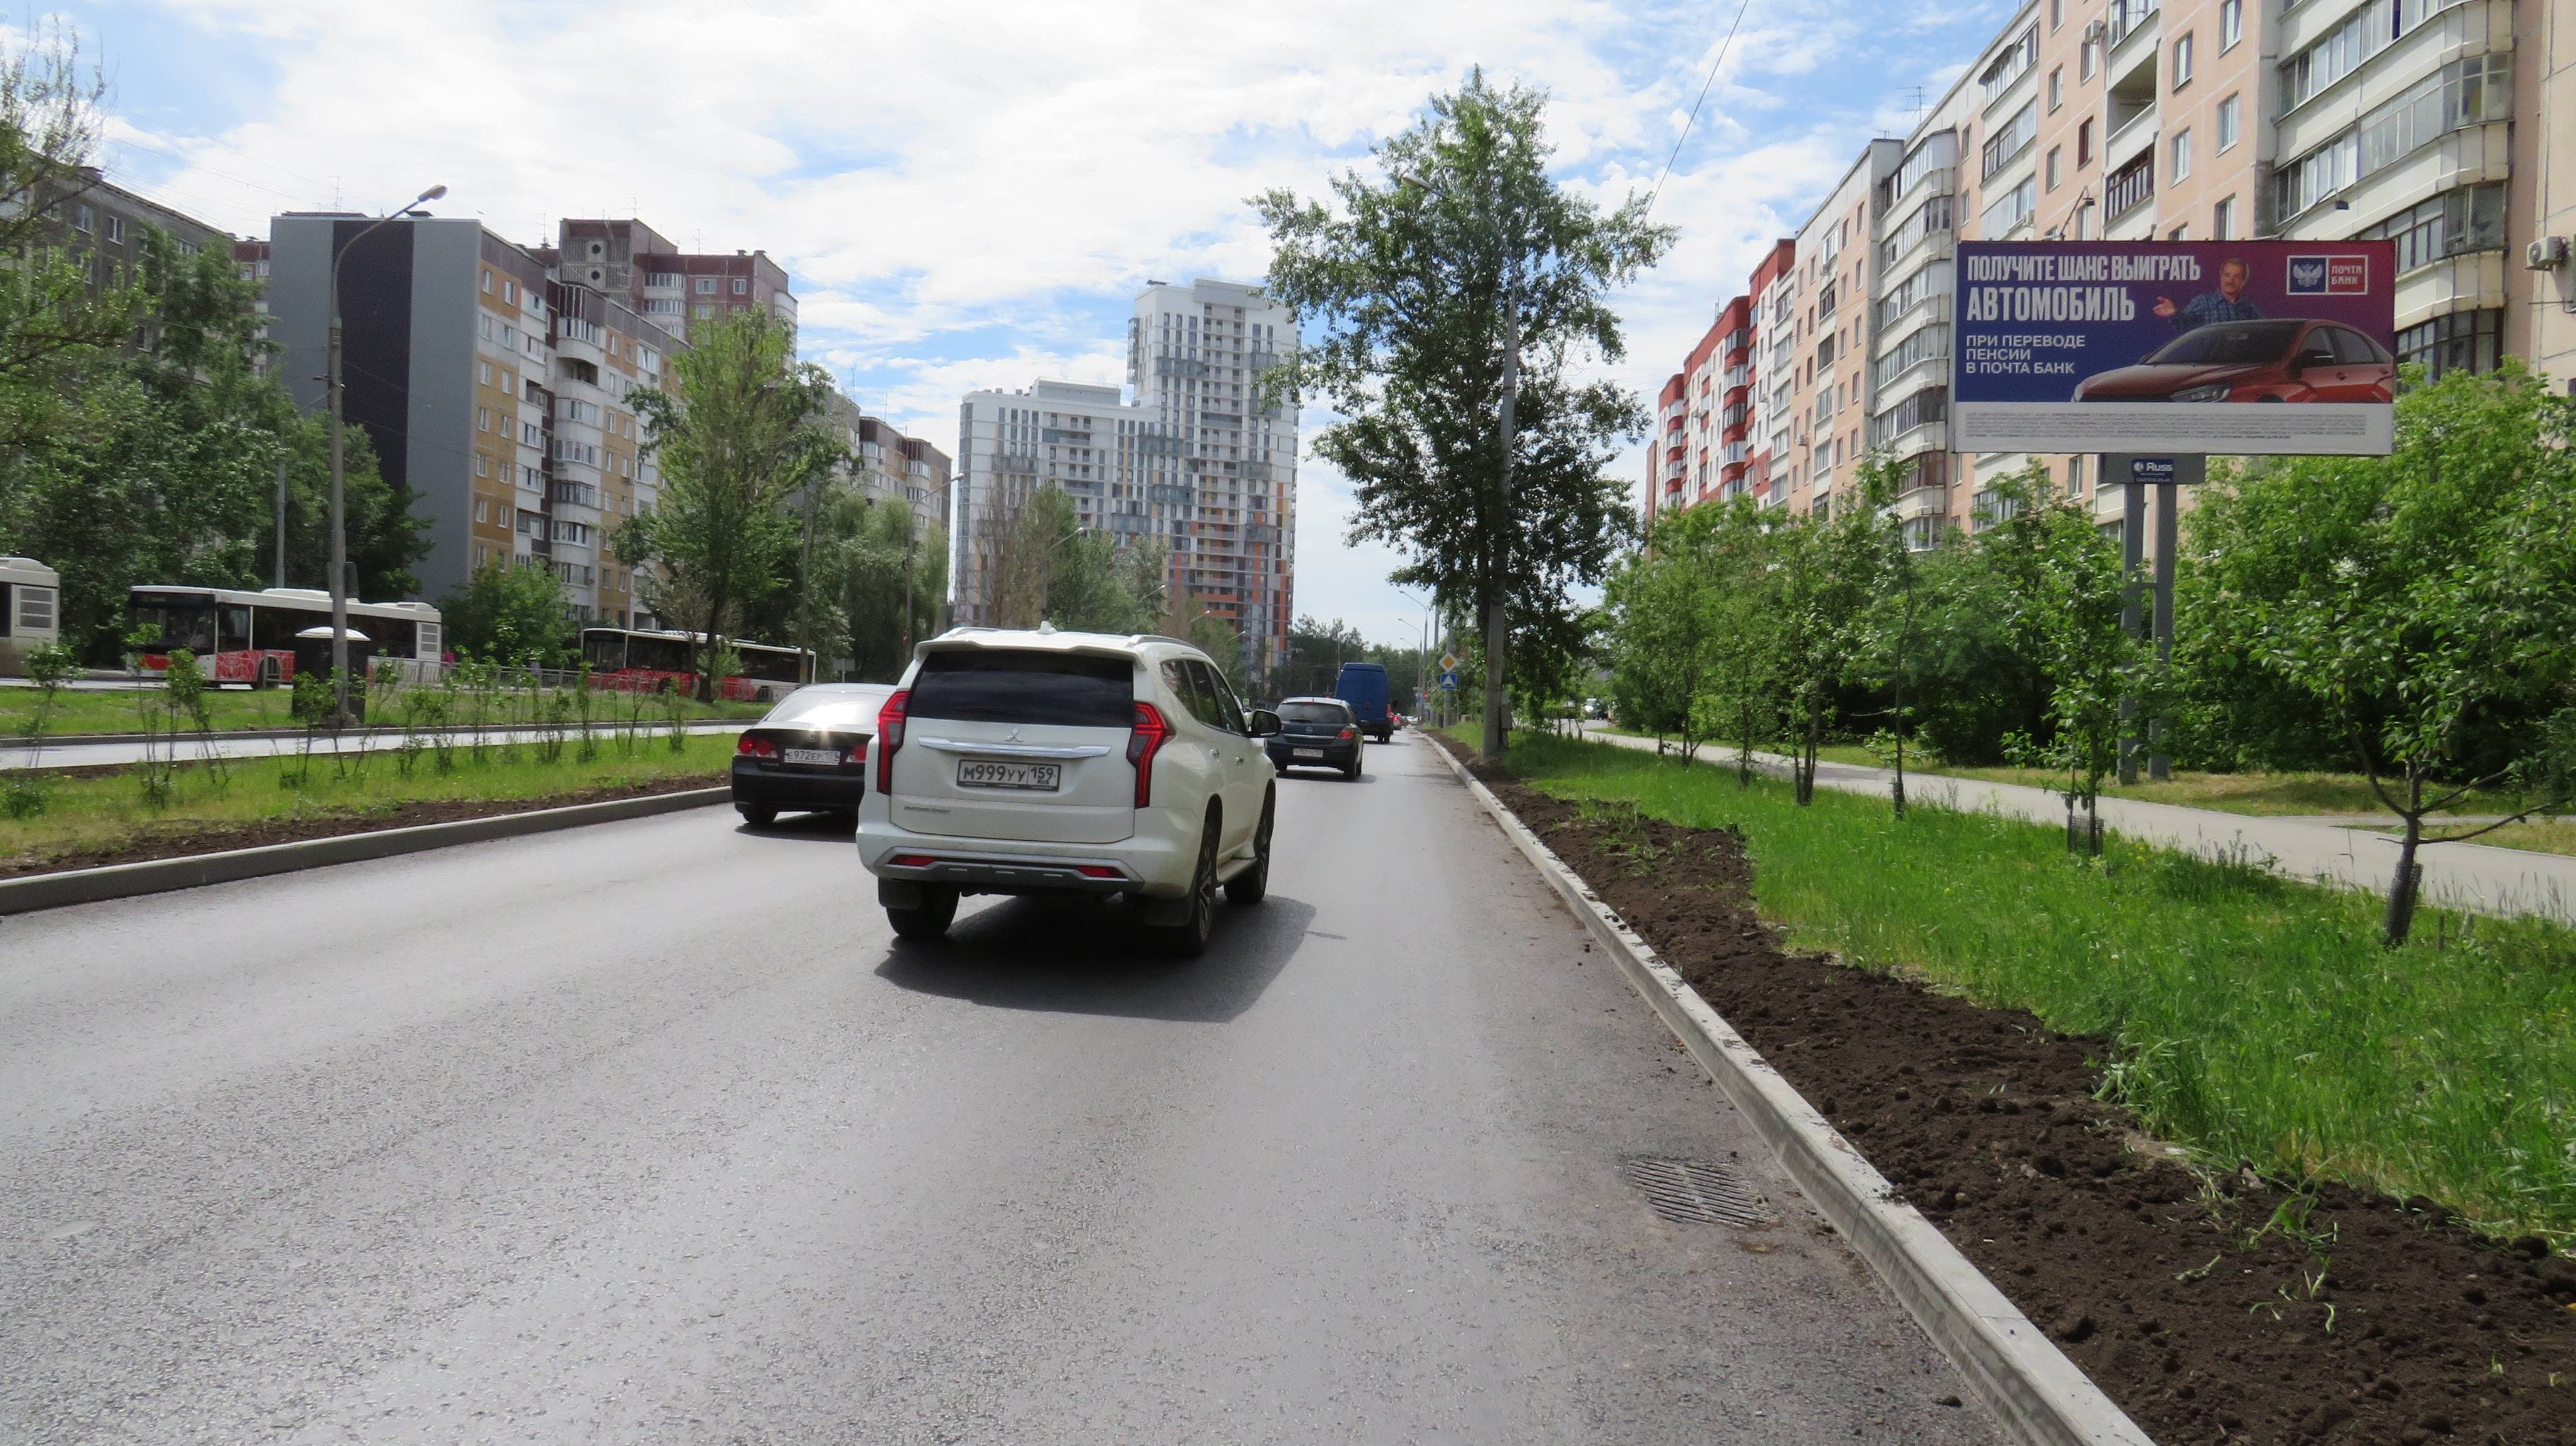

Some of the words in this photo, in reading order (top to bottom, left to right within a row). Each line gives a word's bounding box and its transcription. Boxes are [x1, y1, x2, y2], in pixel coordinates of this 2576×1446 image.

[1967, 255, 2055, 281] ПОЛУЧИТЕ
[2058, 255, 2108, 281] ШАНС
[2111, 255, 2201, 281] ВЫИГРАТЬ
[2332, 265, 2362, 275] ПОЧТА
[2331, 275, 2358, 285] БАНК
[1966, 286, 2135, 321] АВТОМОБИЛЬ
[1966, 335, 1998, 347] ПРИ
[2002, 335, 2086, 349] ПЕРЕВОДЕ
[1966, 349, 2031, 361] ПЕНСИИ
[1966, 362, 1976, 374] В
[1979, 362, 2030, 374] ПОЧТА
[2034, 362, 2075, 374] БАНК
[1030, 766, 1054, 780] 159
